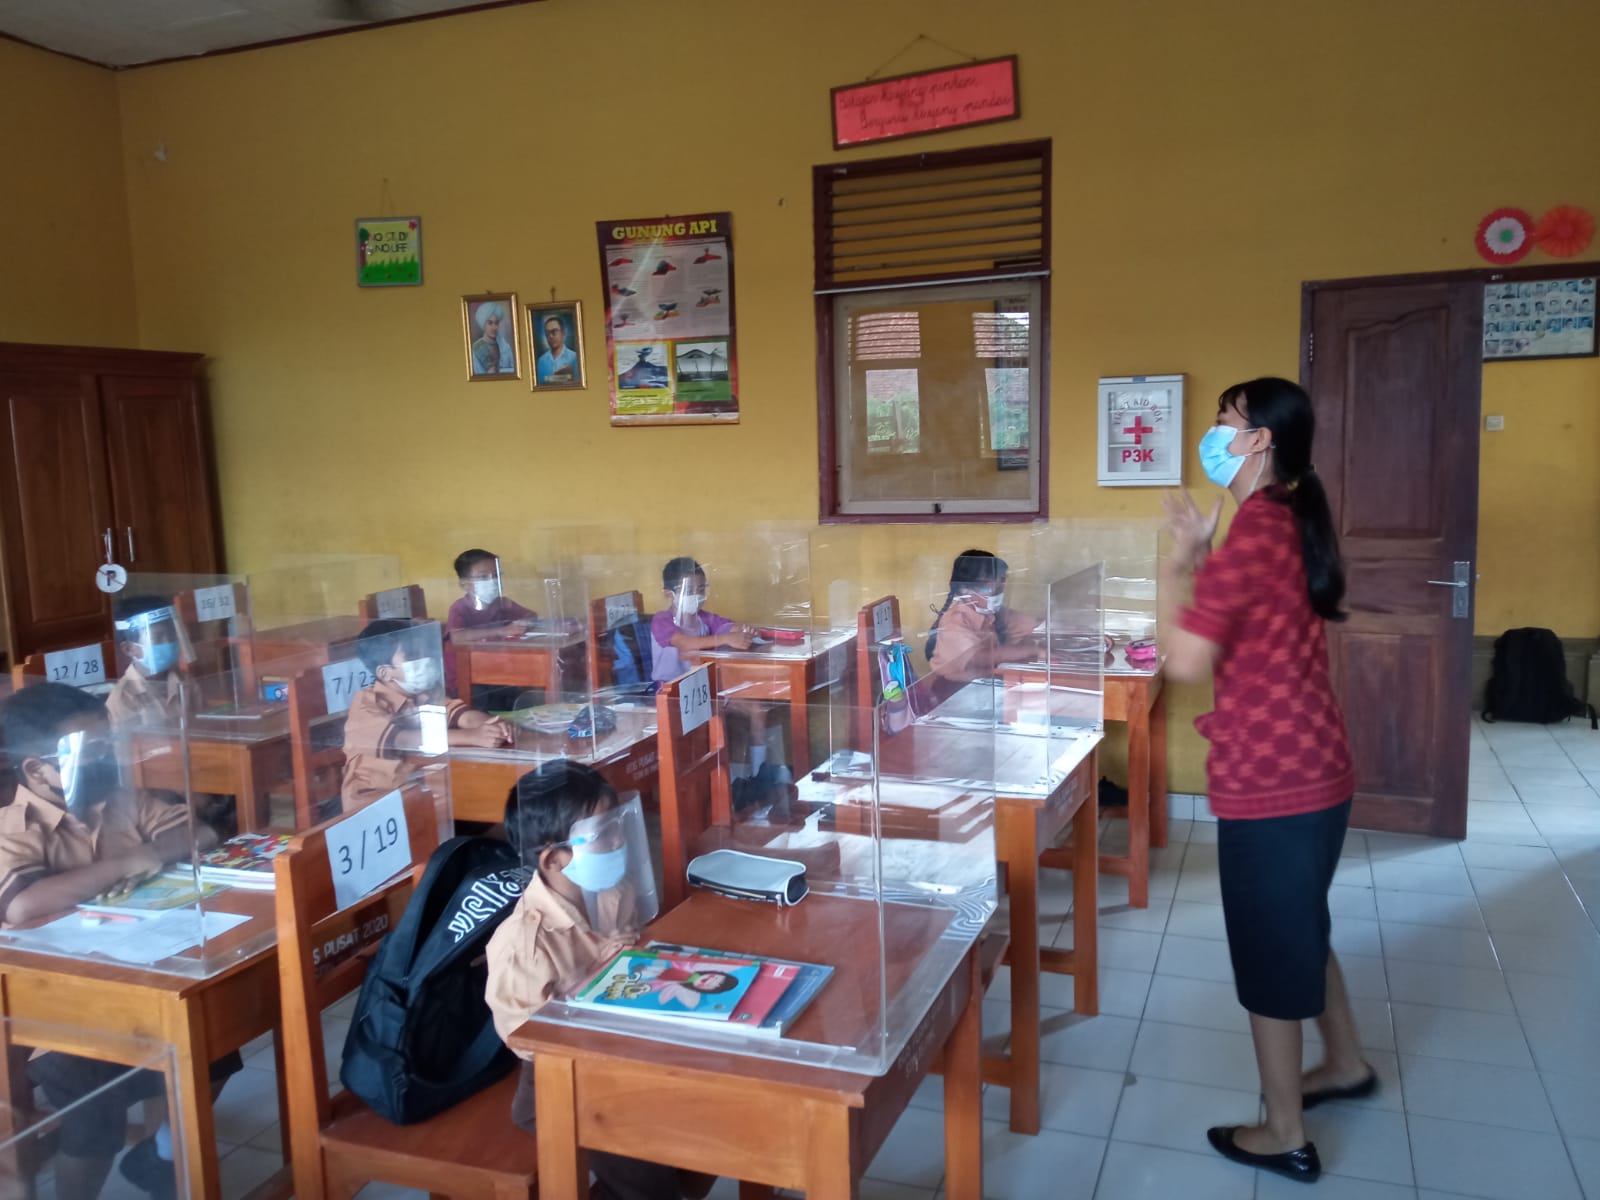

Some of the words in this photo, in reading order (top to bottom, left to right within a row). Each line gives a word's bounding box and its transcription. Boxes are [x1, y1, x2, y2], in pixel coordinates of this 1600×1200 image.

[612, 222, 686, 240] GUNUNG
[689, 219, 717, 235] API
[1121, 448, 1155, 464] P3K
[323, 927, 361, 959] PUSAT
[362, 914, 389, 938] 2020
